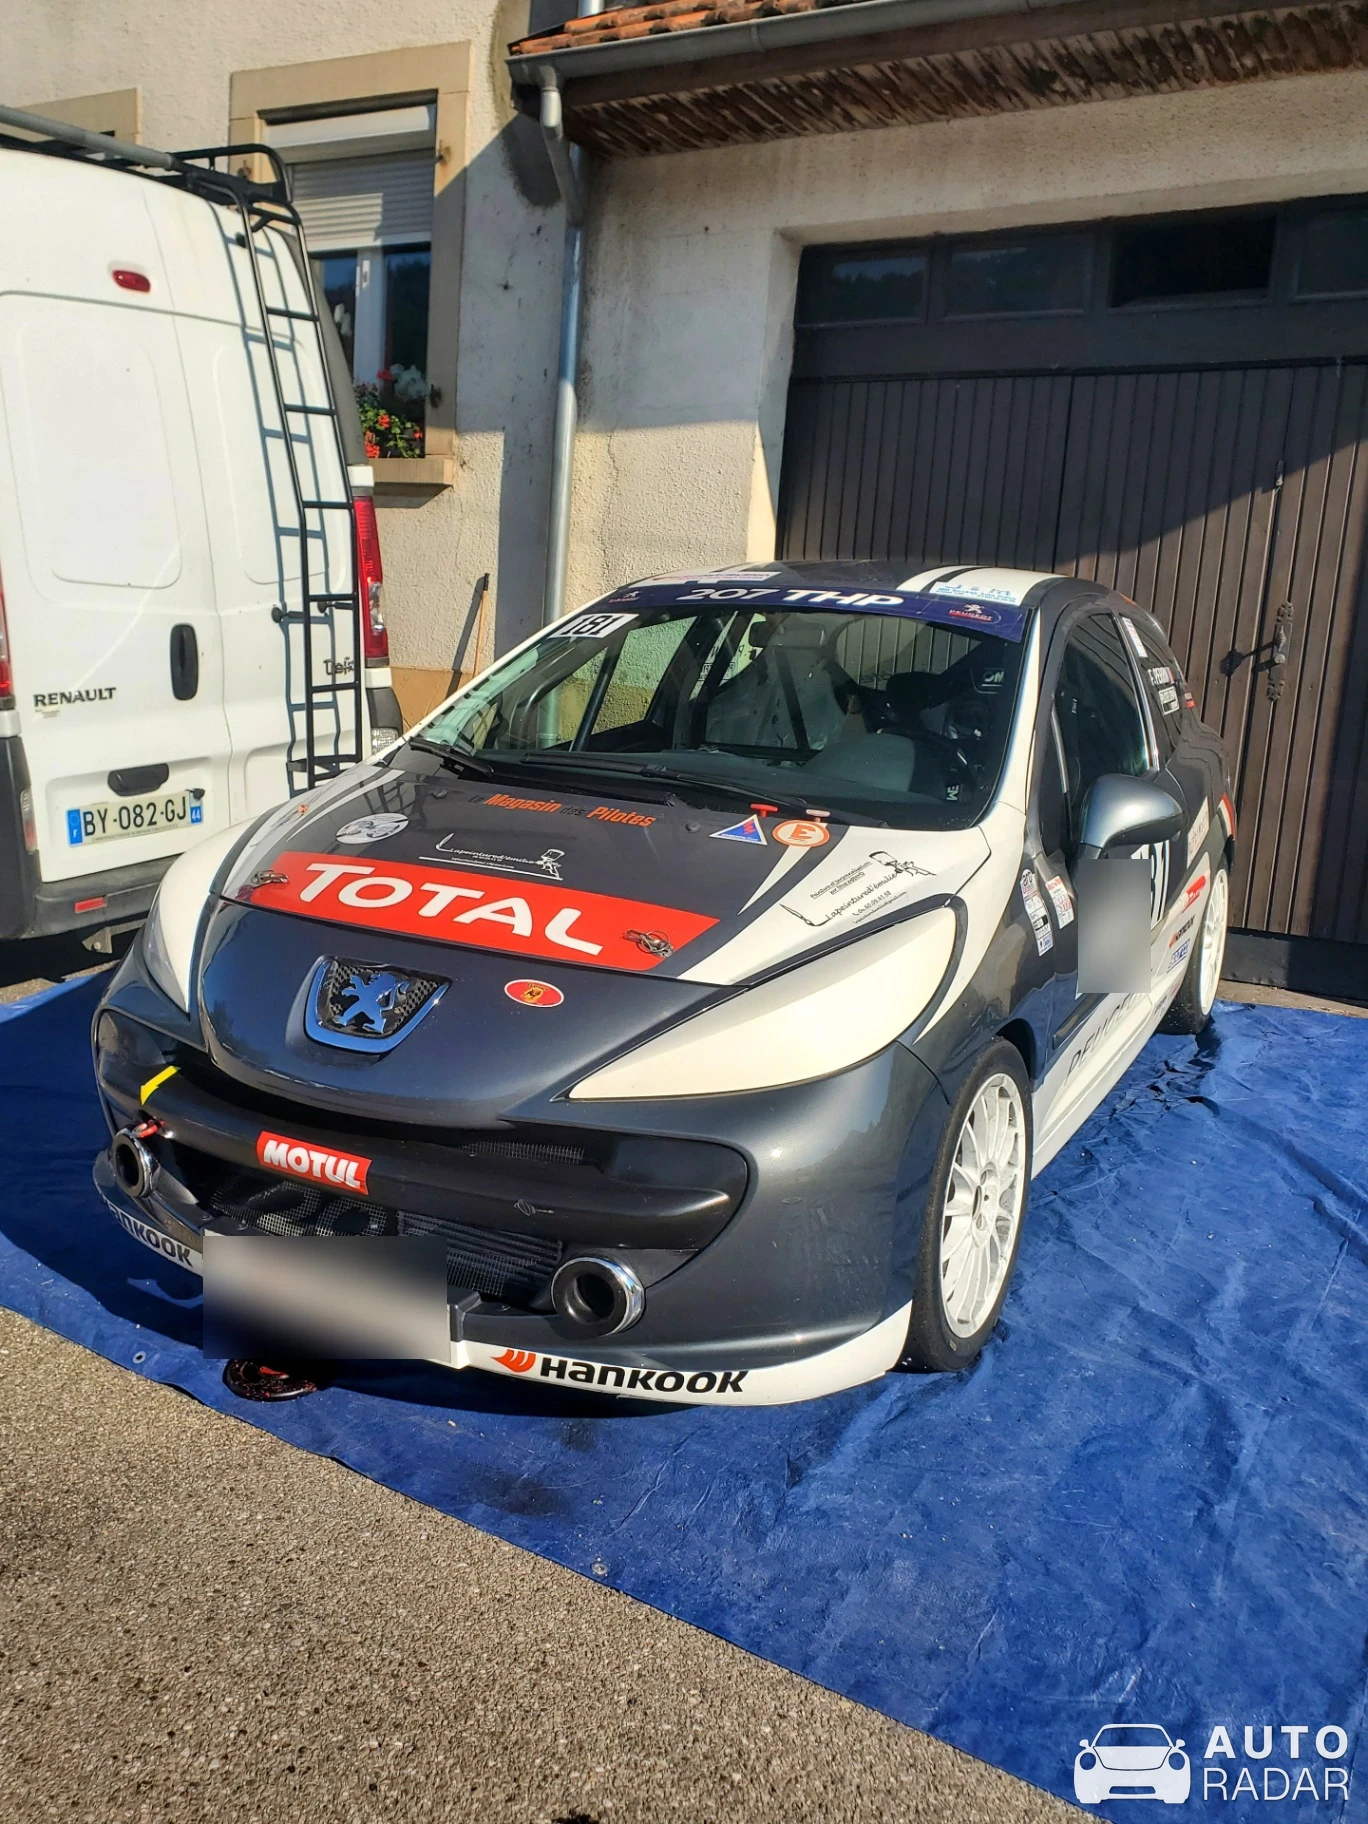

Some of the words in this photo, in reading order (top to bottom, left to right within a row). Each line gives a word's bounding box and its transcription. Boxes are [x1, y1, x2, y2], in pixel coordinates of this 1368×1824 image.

[676, 588, 781, 601] 207
[784, 589, 905, 608] THP
[560, 614, 625, 636] 181
[33, 687, 117, 708] RENAULT
[482, 793, 563, 813] Magasin
[586, 806, 657, 828] Pilotes
[299, 862, 604, 956] TOTAL
[263, 1139, 364, 1188] MOTUL
